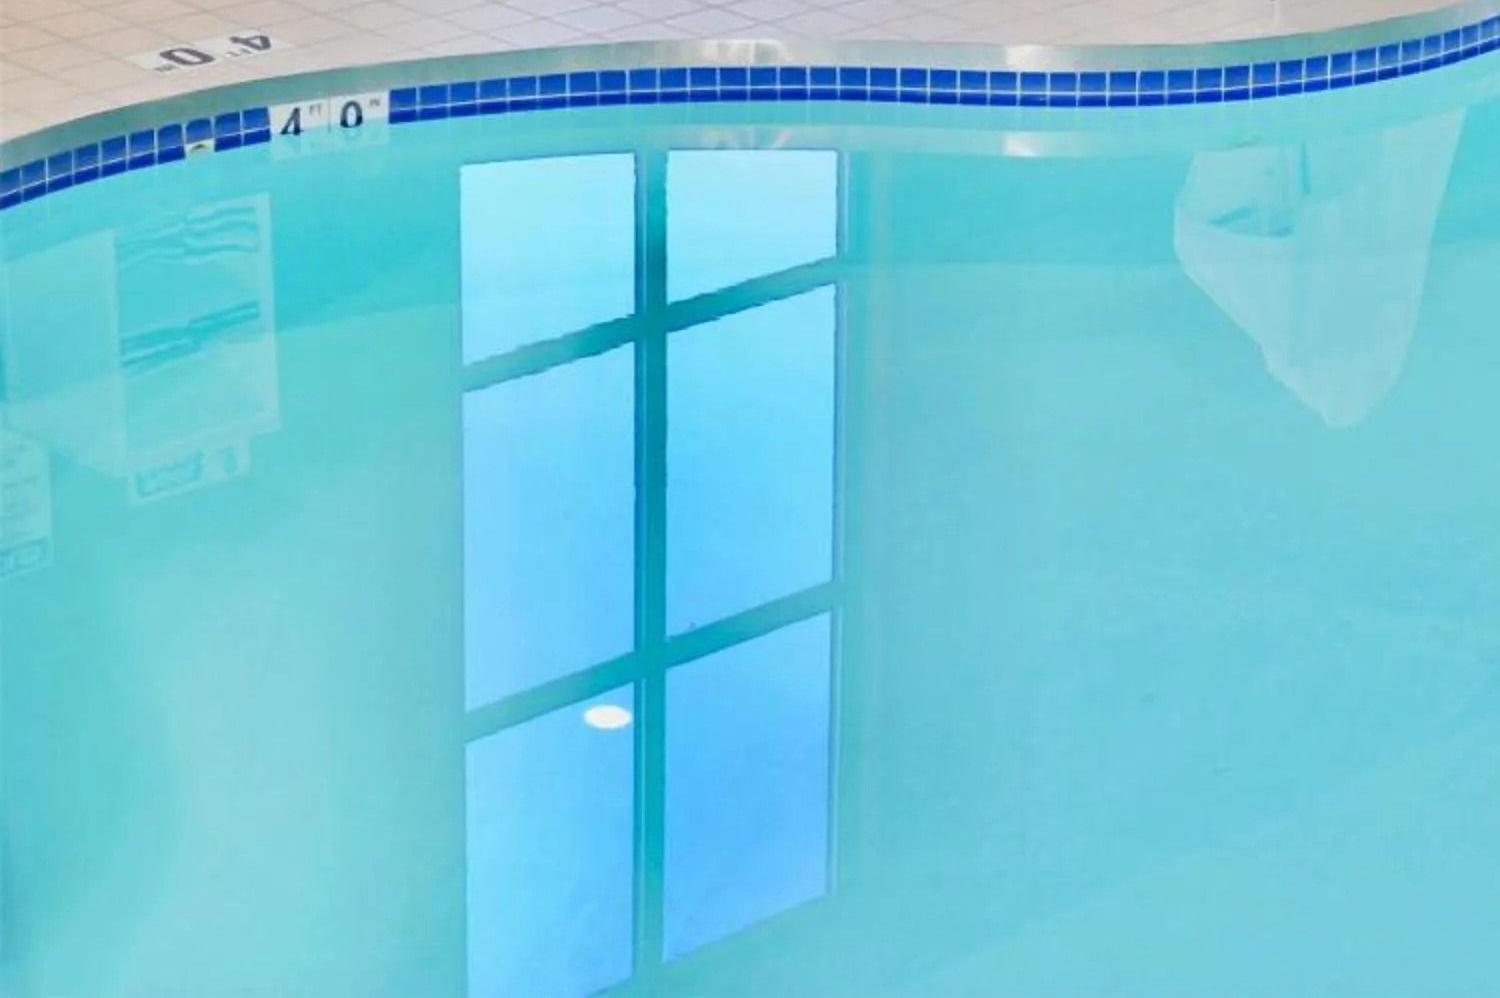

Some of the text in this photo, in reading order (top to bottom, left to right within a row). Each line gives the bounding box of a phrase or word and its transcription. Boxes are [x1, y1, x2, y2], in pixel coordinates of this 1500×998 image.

[229, 35, 272, 51] 4
[159, 47, 216, 66] 0
[280, 106, 302, 136] 4
[340, 100, 364, 129] 0
